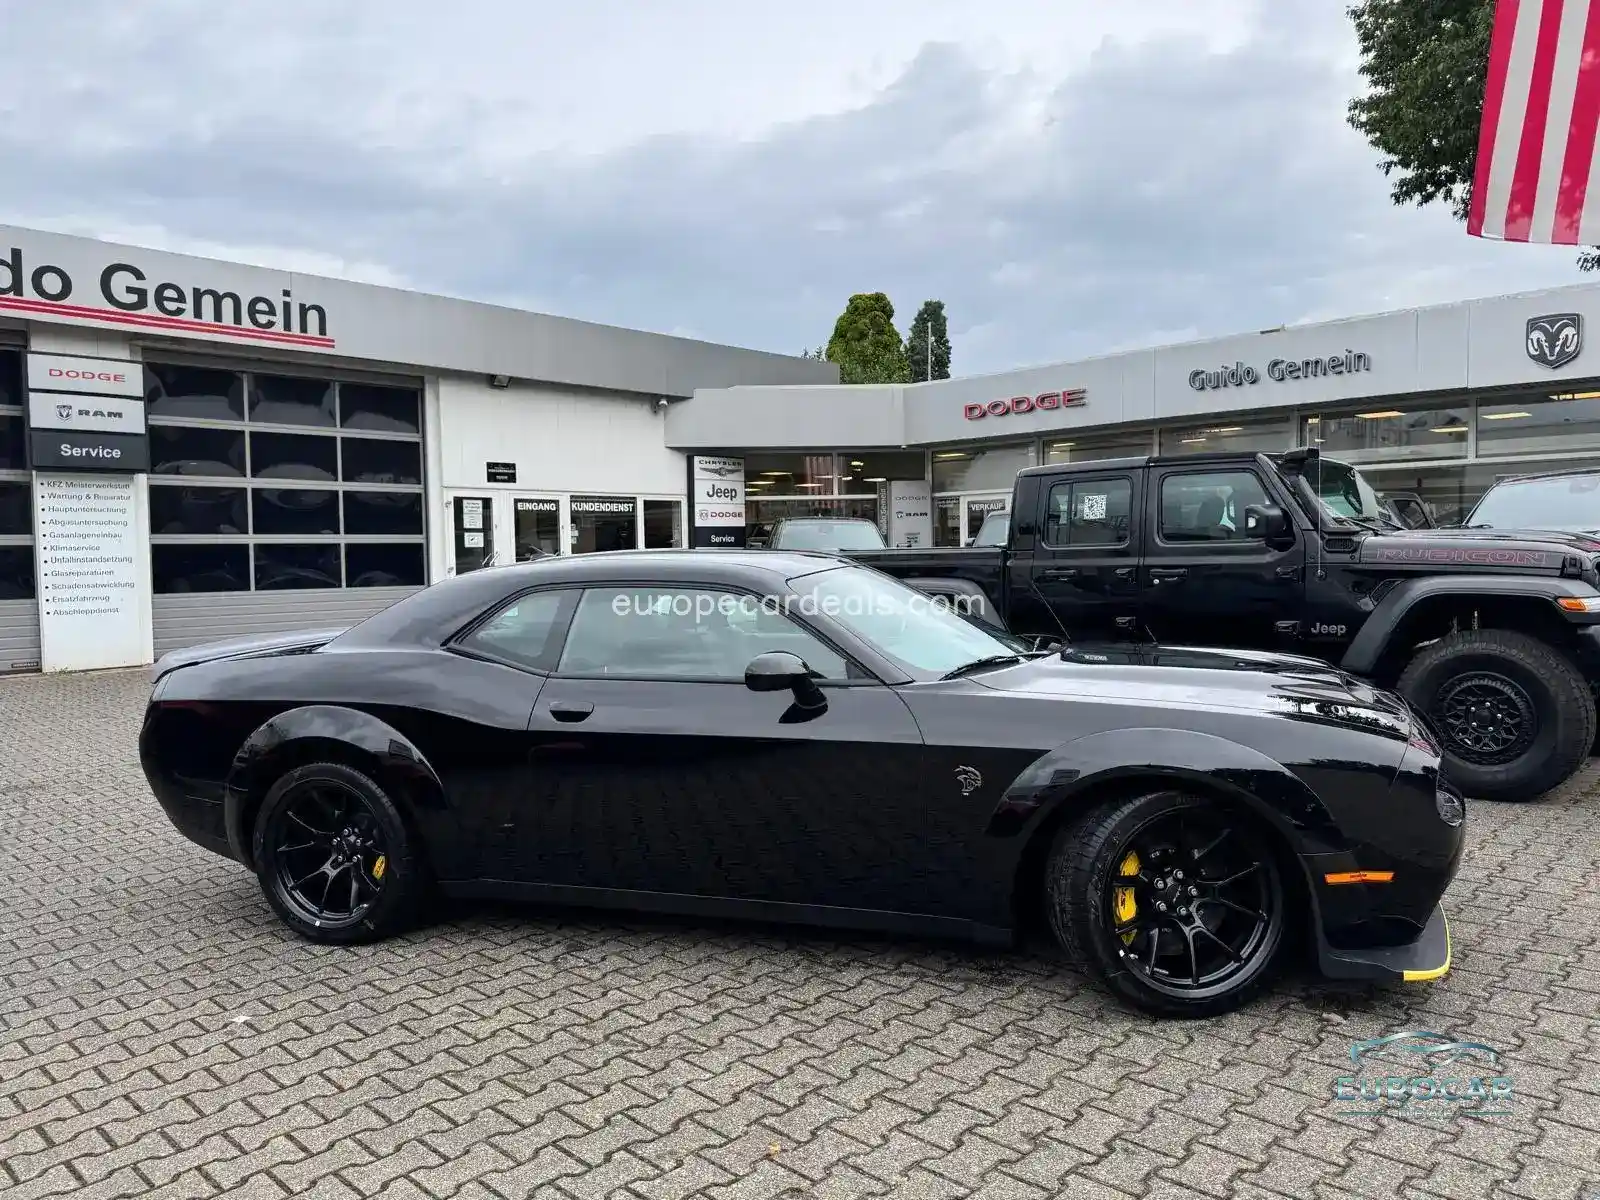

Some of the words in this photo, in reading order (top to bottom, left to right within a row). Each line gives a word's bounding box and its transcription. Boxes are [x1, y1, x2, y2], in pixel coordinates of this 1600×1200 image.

[100, 263, 327, 336] Gemein
[1188, 361, 1258, 390] Guido
[1267, 349, 1370, 382] Gemein
[48, 369, 126, 383] DODGE
[964, 388, 1087, 420] DODGE
[78, 409, 123, 418] RAM
[60, 443, 121, 459] Service
[47, 480, 63, 488] KFZ
[47, 492, 83, 501] Wartung
[706, 484, 738, 501] Jeep
[48, 505, 127, 515] Hauptuntersuchung
[517, 502, 557, 511] EINGANG
[571, 502, 634, 512] KUNDENDIENST
[971, 503, 1004, 511] VERKAUF
[48, 518, 128, 527] Abgasuntersuchung
[49, 531, 122, 540] Gasanlageneinbau
[710, 534, 735, 544] Service
[50, 544, 101, 552] Klimaservice
[50, 555, 133, 564] Unfallinstandsetzung
[1376, 547, 1546, 565] RUBICON
[51, 569, 115, 577] Glasreparaturen
[51, 581, 135, 590] Schadensabwicklung
[52, 594, 110, 602] Ersatzfahrzeug
[53, 607, 119, 616] Abschleppdienst
[1310, 622, 1347, 637] Jeep
